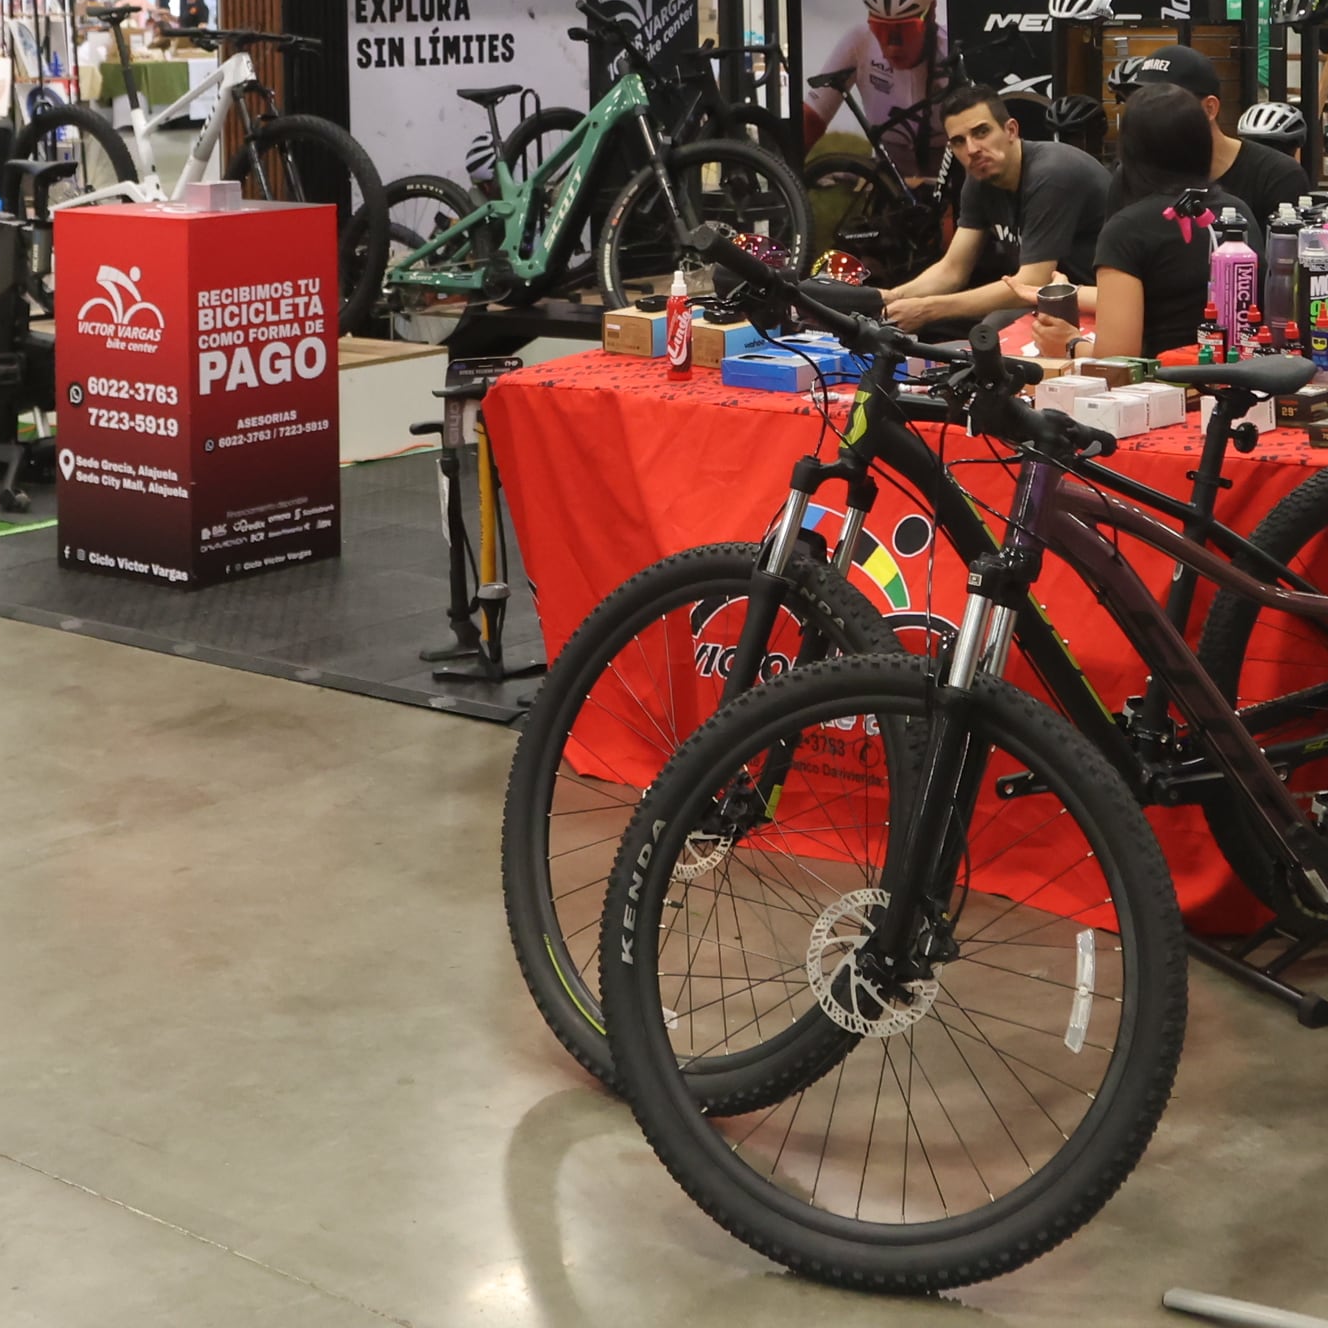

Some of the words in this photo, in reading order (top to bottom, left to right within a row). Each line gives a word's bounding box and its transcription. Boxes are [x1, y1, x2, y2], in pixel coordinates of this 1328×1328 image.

[357, 37, 404, 69] SIN
[415, 27, 515, 67] LÍMITES
[544, 166, 583, 252] SCOTT
[198, 281, 293, 307] RECIBIMOS
[298, 278, 320, 294] TU
[198, 295, 324, 331] BICICLETA
[78, 321, 116, 336] VICTOR
[117, 325, 162, 342] VARGAS
[106, 337, 126, 350] bike
[127, 342, 158, 353] center
[198, 330, 244, 349] COMO
[249, 323, 301, 342] FORMA
[305, 319, 324, 334] DE
[199, 336, 327, 395] PAGO
[87, 376, 178, 405] 6022-3763
[88, 407, 179, 437] 7223-5919
[237, 410, 297, 429] ASESORIAS
[218, 430, 271, 448] 6022-3763
[75, 471, 99, 485] Sede
[101, 475, 121, 490] City
[89, 552, 116, 568] Ciclo
[117, 557, 149, 573] Victor
[151, 564, 188, 582] Vargas
[800, 586, 845, 629] NDA
[621, 819, 666, 965] KENDA
